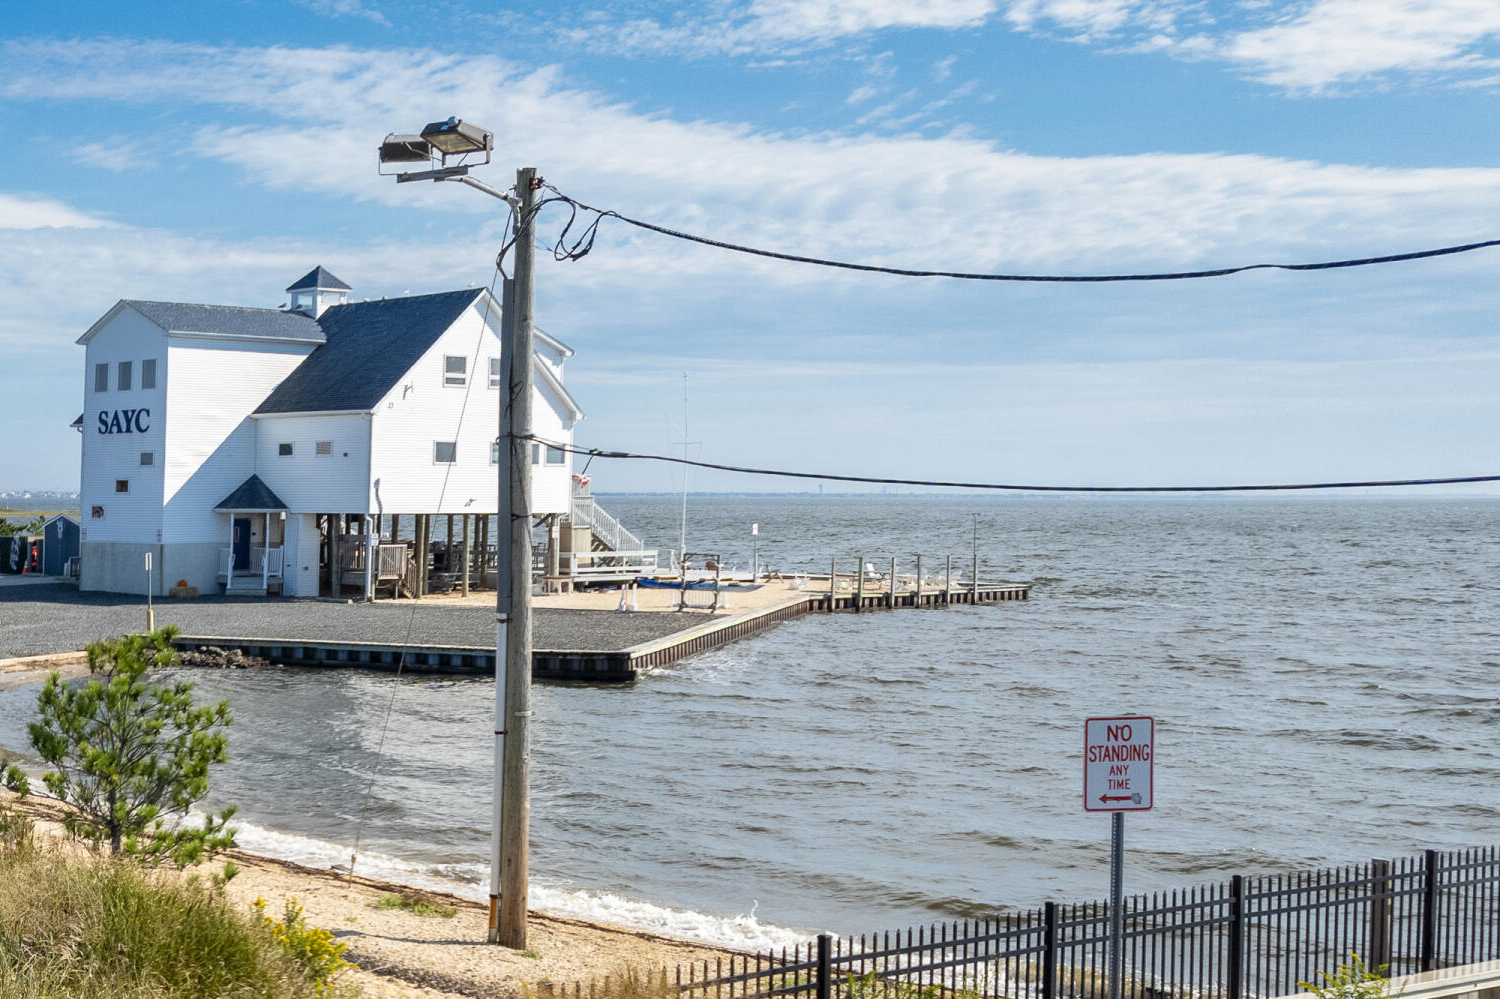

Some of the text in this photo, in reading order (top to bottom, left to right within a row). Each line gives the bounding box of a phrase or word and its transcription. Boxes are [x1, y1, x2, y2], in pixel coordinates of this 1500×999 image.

[98, 408, 150, 434] SAYC
[1106, 724, 1133, 742] NO
[1089, 744, 1150, 763] STANDING
[1109, 765, 1130, 776] ANY
[1108, 778, 1132, 790] TIME
